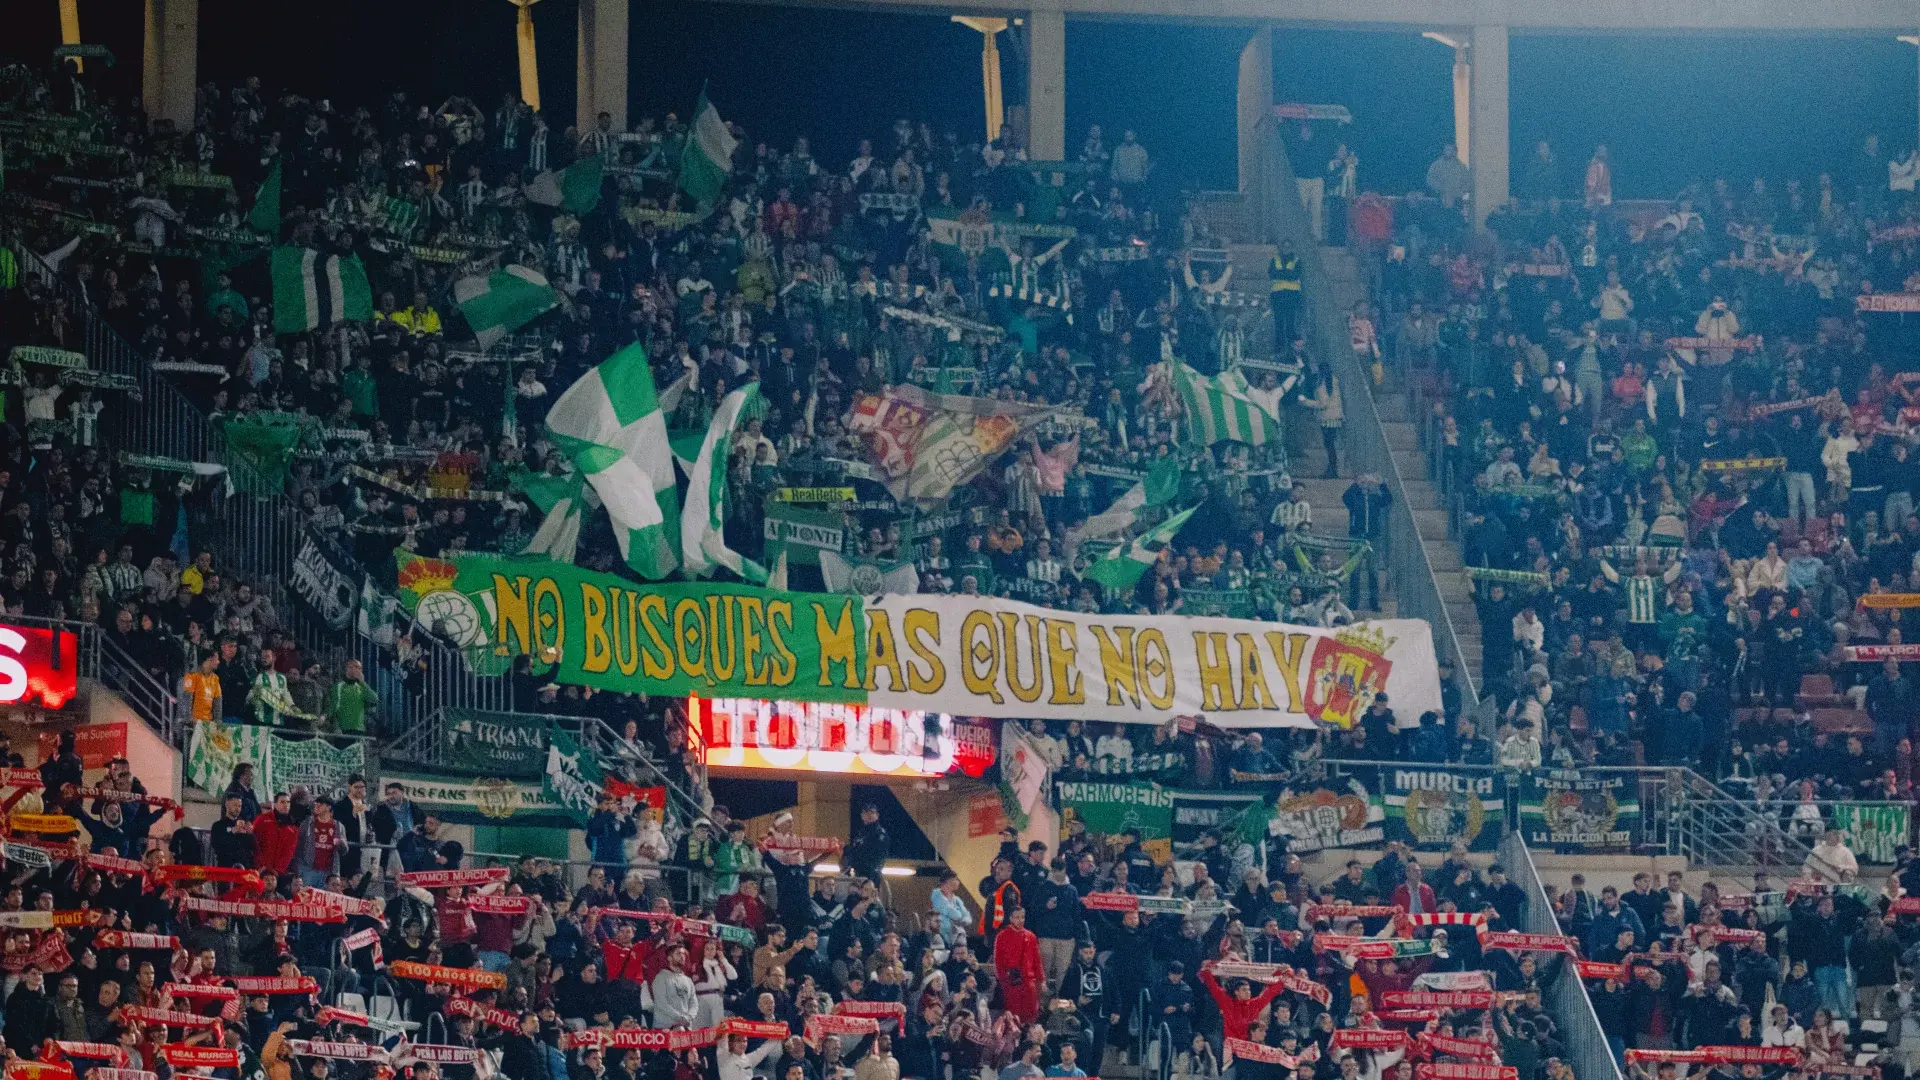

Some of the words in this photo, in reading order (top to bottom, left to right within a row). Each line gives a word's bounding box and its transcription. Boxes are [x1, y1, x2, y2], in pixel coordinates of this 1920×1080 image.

[792, 488, 815, 501] Real
[816, 488, 843, 501] Betis
[492, 573, 565, 665] NO
[580, 583, 796, 688] BUSQUES
[812, 595, 946, 695] MÁS
[960, 608, 1085, 705] QUE
[1100, 623, 1175, 711] NO
[1192, 630, 1311, 714] HAY
[476, 721, 543, 749] TRIANA
[296, 762, 337, 778] BETIS
[1395, 769, 1494, 794] MURCIA
[103, 788, 142, 800] murcia
[427, 784, 467, 801] FANS
[1532, 831, 1548, 843] LA
[416, 872, 449, 882] VAMOS
[453, 870, 490, 881] MURCIA
[489, 896, 523, 908] MURCIA
[73, 912, 83, 924] CF
[1493, 934, 1526, 944] VAMOS
[1529, 936, 1566, 946] MURCIA
[407, 963, 431, 977] 100
[435, 967, 466, 982] AÑOS
[467, 969, 494, 984] 100
[615, 1030, 666, 1046] murcia
[1340, 1032, 1364, 1042] Real
[1366, 1032, 1402, 1042] Murcia
[331, 1043, 345, 1055] LOS
[415, 1047, 435, 1059] PEÑA
[437, 1048, 452, 1060] LOS
[171, 1050, 195, 1059] REAL
[199, 1052, 233, 1061] MURCIA
